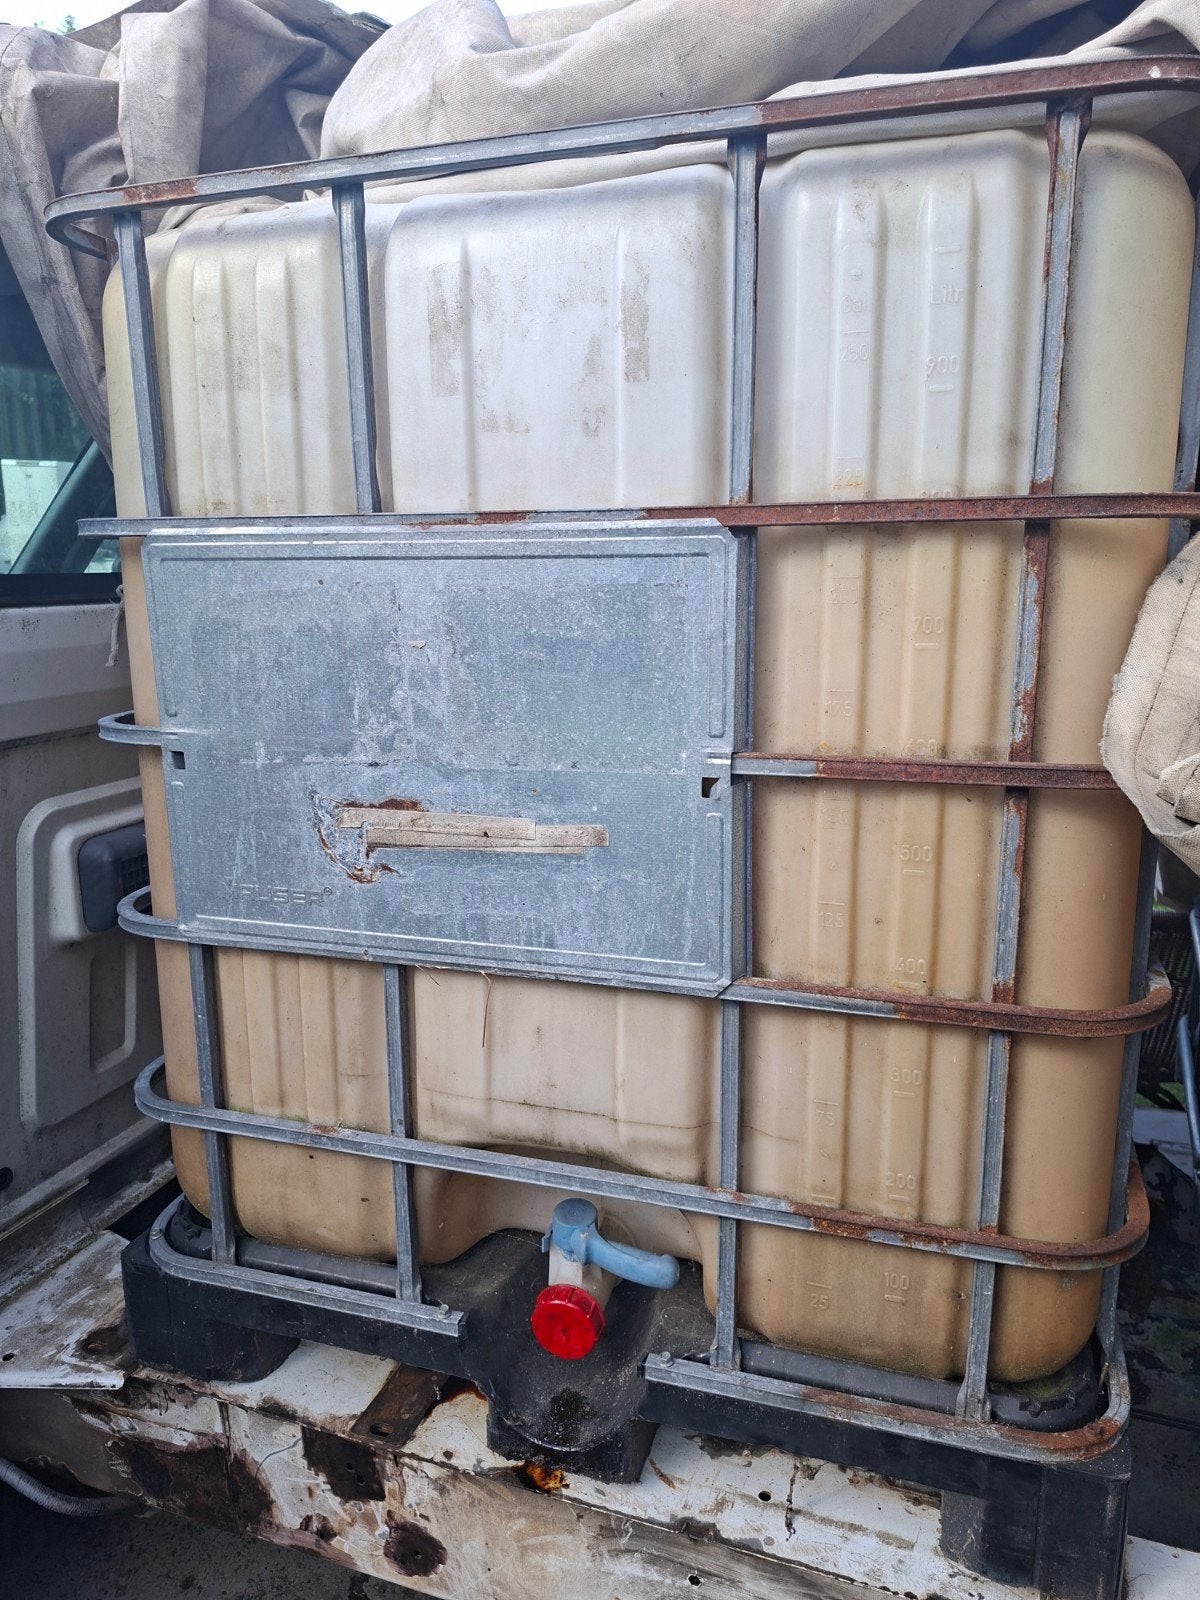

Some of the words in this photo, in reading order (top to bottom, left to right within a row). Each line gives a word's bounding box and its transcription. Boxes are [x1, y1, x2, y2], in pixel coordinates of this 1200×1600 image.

[925, 355, 960, 375] 900
[911, 616, 945, 634] 700
[824, 700, 854, 717] 175
[899, 844, 933, 863] 500
[818, 911, 845, 928] 125
[895, 957, 928, 976] 400
[890, 1067, 923, 1086] 300
[885, 1171, 917, 1190] 200
[884, 1271, 911, 1291] 100
[810, 1293, 830, 1310] 25
